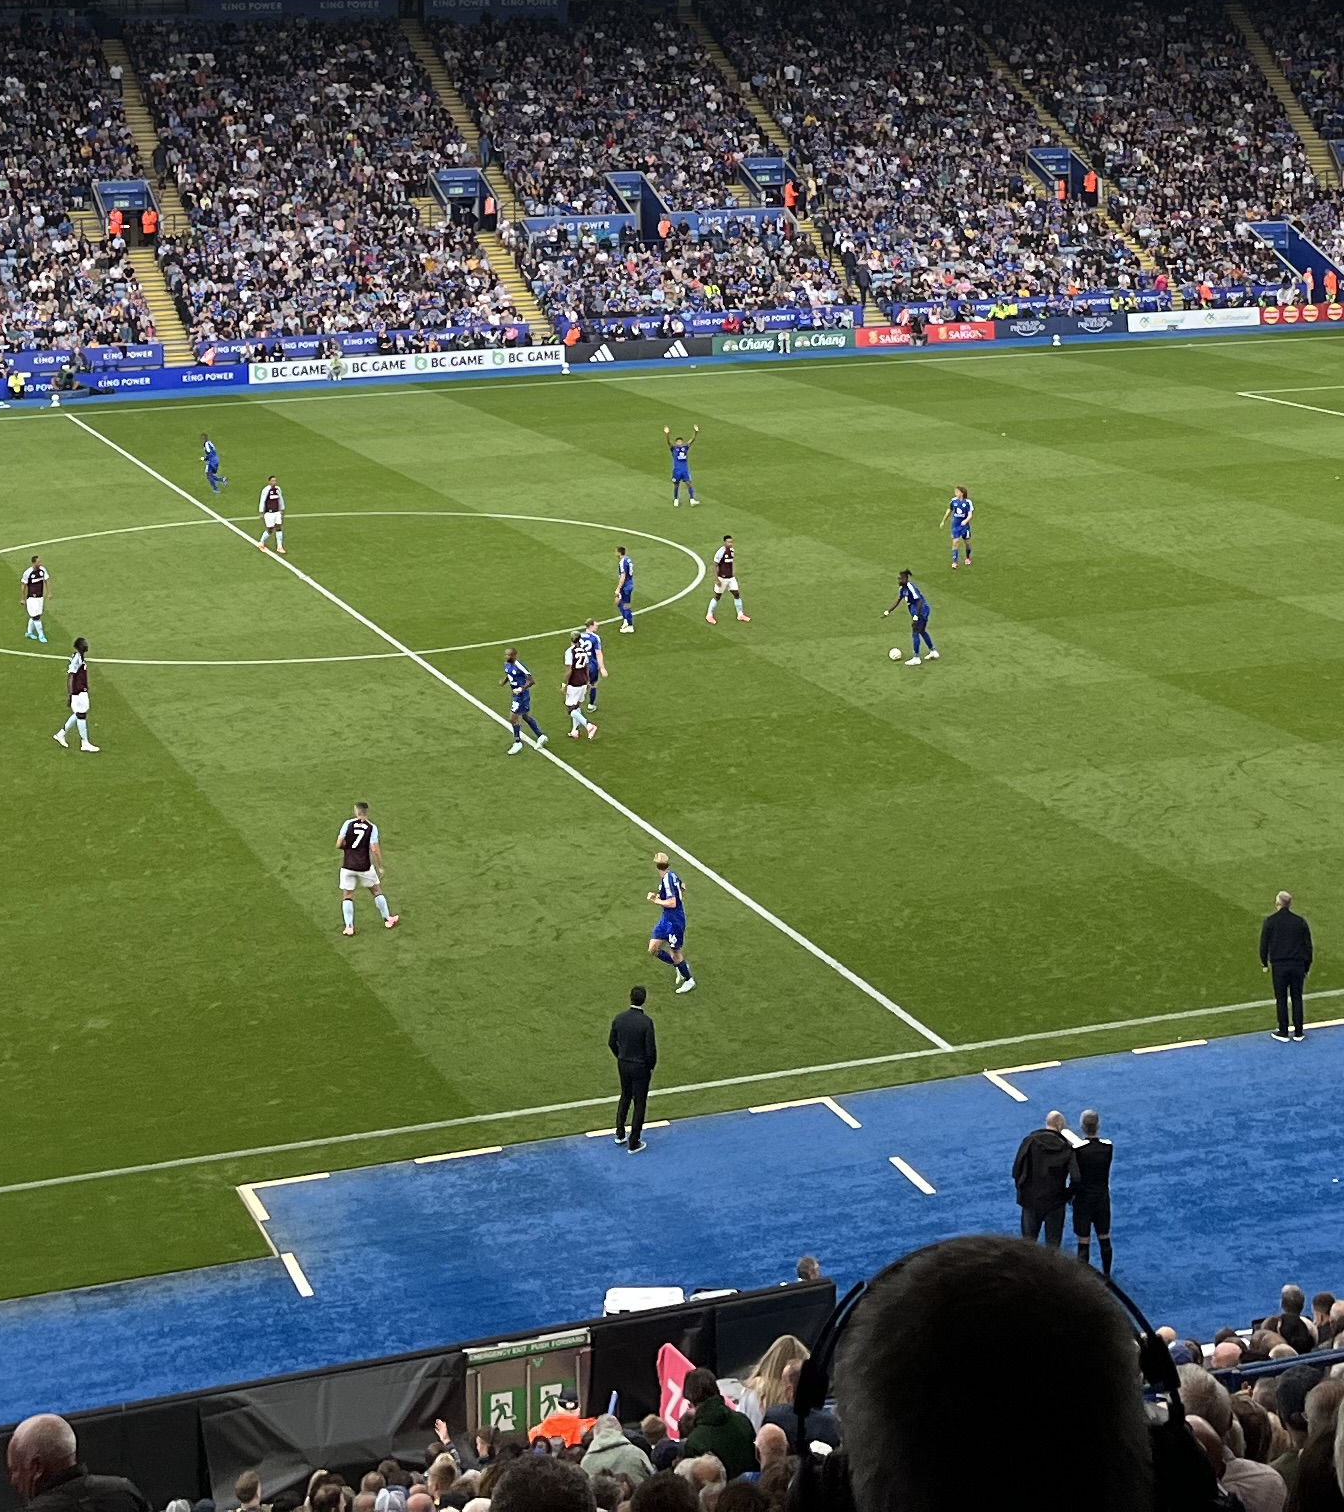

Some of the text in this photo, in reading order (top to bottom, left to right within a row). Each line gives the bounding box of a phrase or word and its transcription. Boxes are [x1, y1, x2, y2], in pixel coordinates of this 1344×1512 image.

[221, 1, 282, 10] KING POWER
[320, 0, 380, 9] KING POWER
[739, 338, 774, 351] Chang
[811, 333, 846, 347] Chang
[431, 355, 484, 367] BC.GAME
[509, 350, 560, 363] BC.GAME
[272, 365, 327, 378] BC.GAME
[352, 360, 406, 373] BC.GAME
[97, 377, 150, 388] KING POWER
[182, 372, 234, 382] KING POWER
[351, 829, 365, 849] 7
[512, 1345, 527, 1355] EXIT
